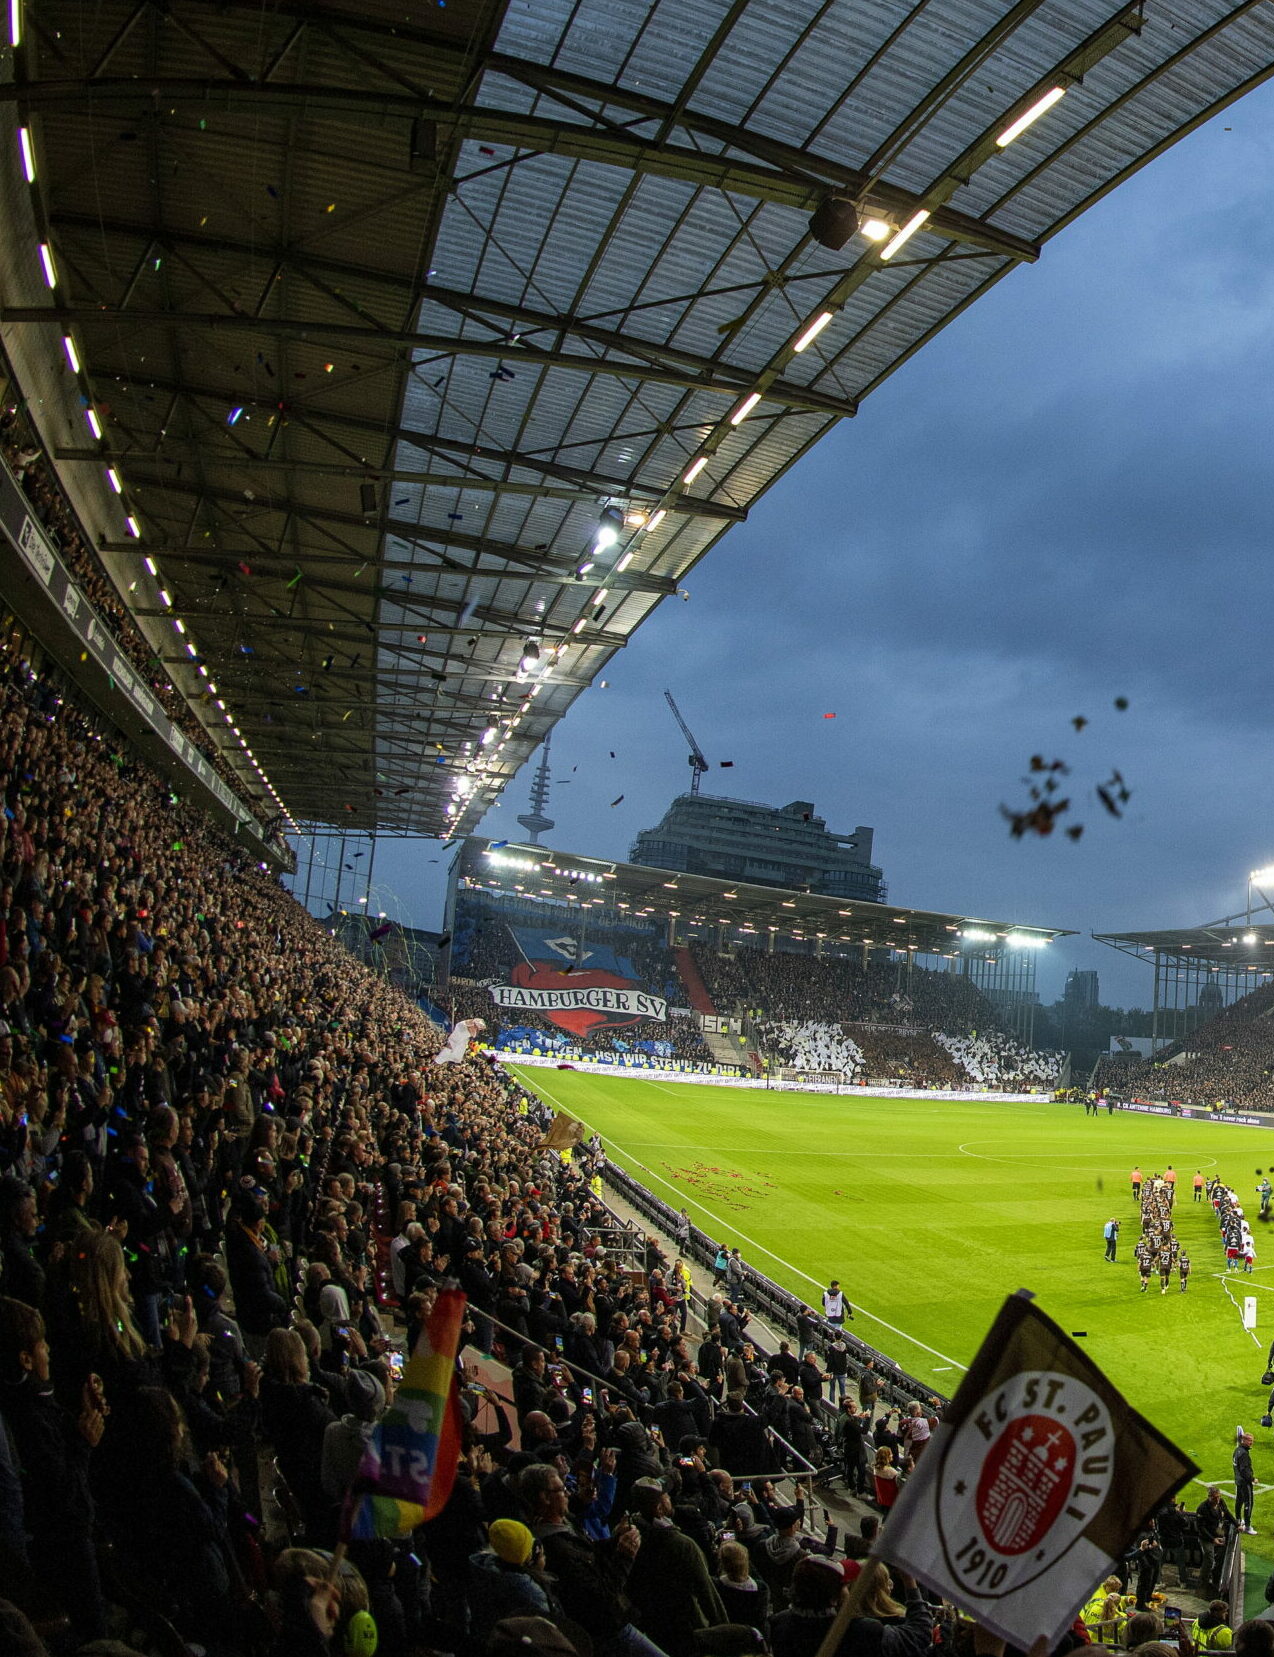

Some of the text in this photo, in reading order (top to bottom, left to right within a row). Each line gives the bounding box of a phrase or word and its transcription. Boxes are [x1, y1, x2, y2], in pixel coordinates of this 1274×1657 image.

[499, 988, 666, 1017] HAMBURGER SV
[973, 1377, 1108, 1521] FC ST. PAULI
[954, 1536, 1010, 1590] 1910
